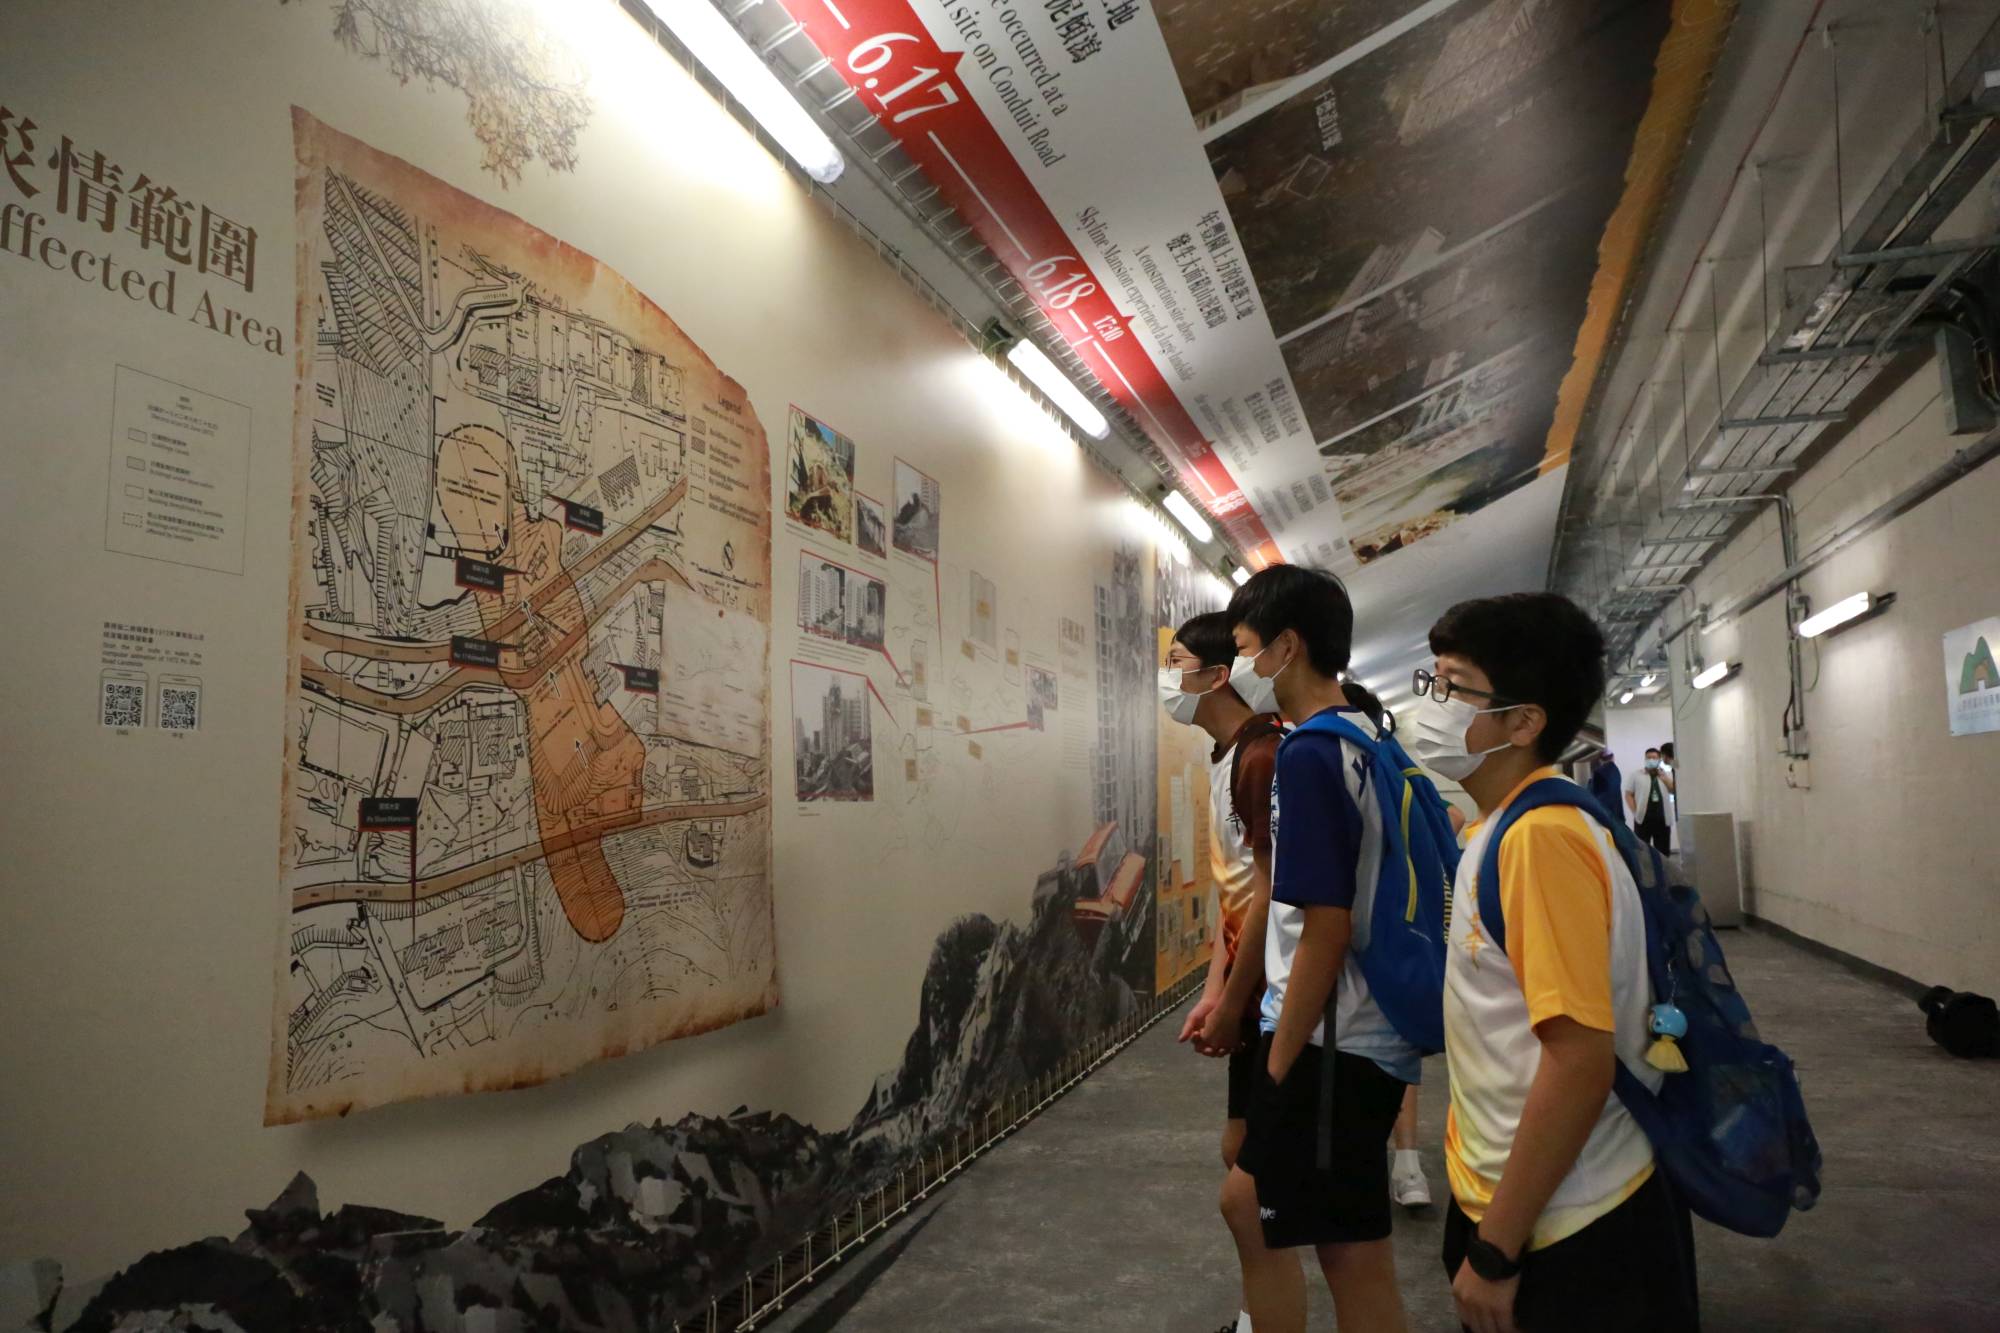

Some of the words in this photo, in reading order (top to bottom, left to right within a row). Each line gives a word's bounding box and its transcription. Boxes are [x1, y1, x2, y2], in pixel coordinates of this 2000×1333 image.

[847, 32, 960, 124] 6.17
[999, 8, 1061, 89] occurred
[949, 9, 983, 44] site
[973, 43, 998, 70] on
[989, 65, 1041, 133] Conduit
[1027, 128, 1067, 168] Road
[1042, 86, 1063, 105] at
[1052, 103, 1069, 117] a
[1024, 256, 1096, 310] 6.18
[1076, 205, 1110, 248] Skyline
[1104, 244, 1134, 287] Mansion
[1125, 281, 1168, 335] experienced
[1138, 252, 1177, 311] construction
[1172, 303, 1187, 323] site
[188, 290, 284, 356] Area
